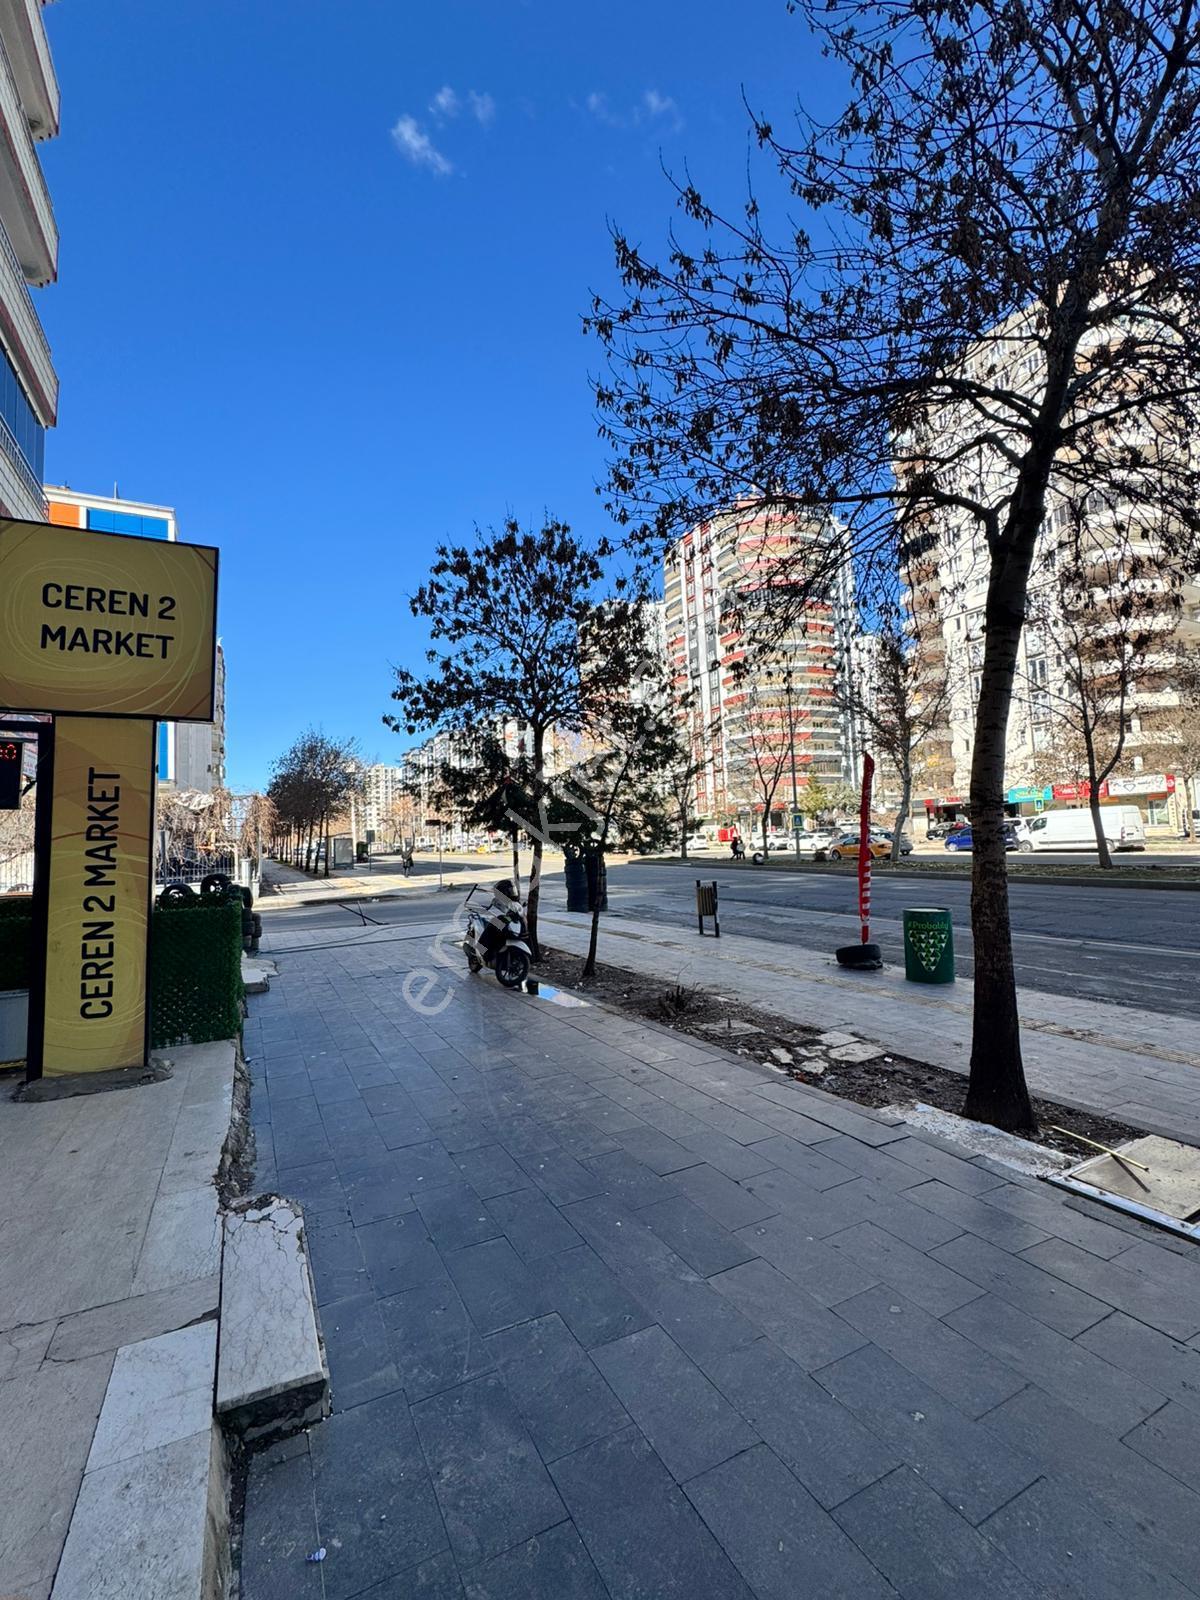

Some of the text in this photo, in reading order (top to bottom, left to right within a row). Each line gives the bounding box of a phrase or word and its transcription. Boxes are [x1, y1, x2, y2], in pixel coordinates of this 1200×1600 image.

[42, 583, 176, 620] CEREN 2
[41, 624, 175, 659] MARKET
[80, 767, 121, 1020] CEREN 2 MARKET
